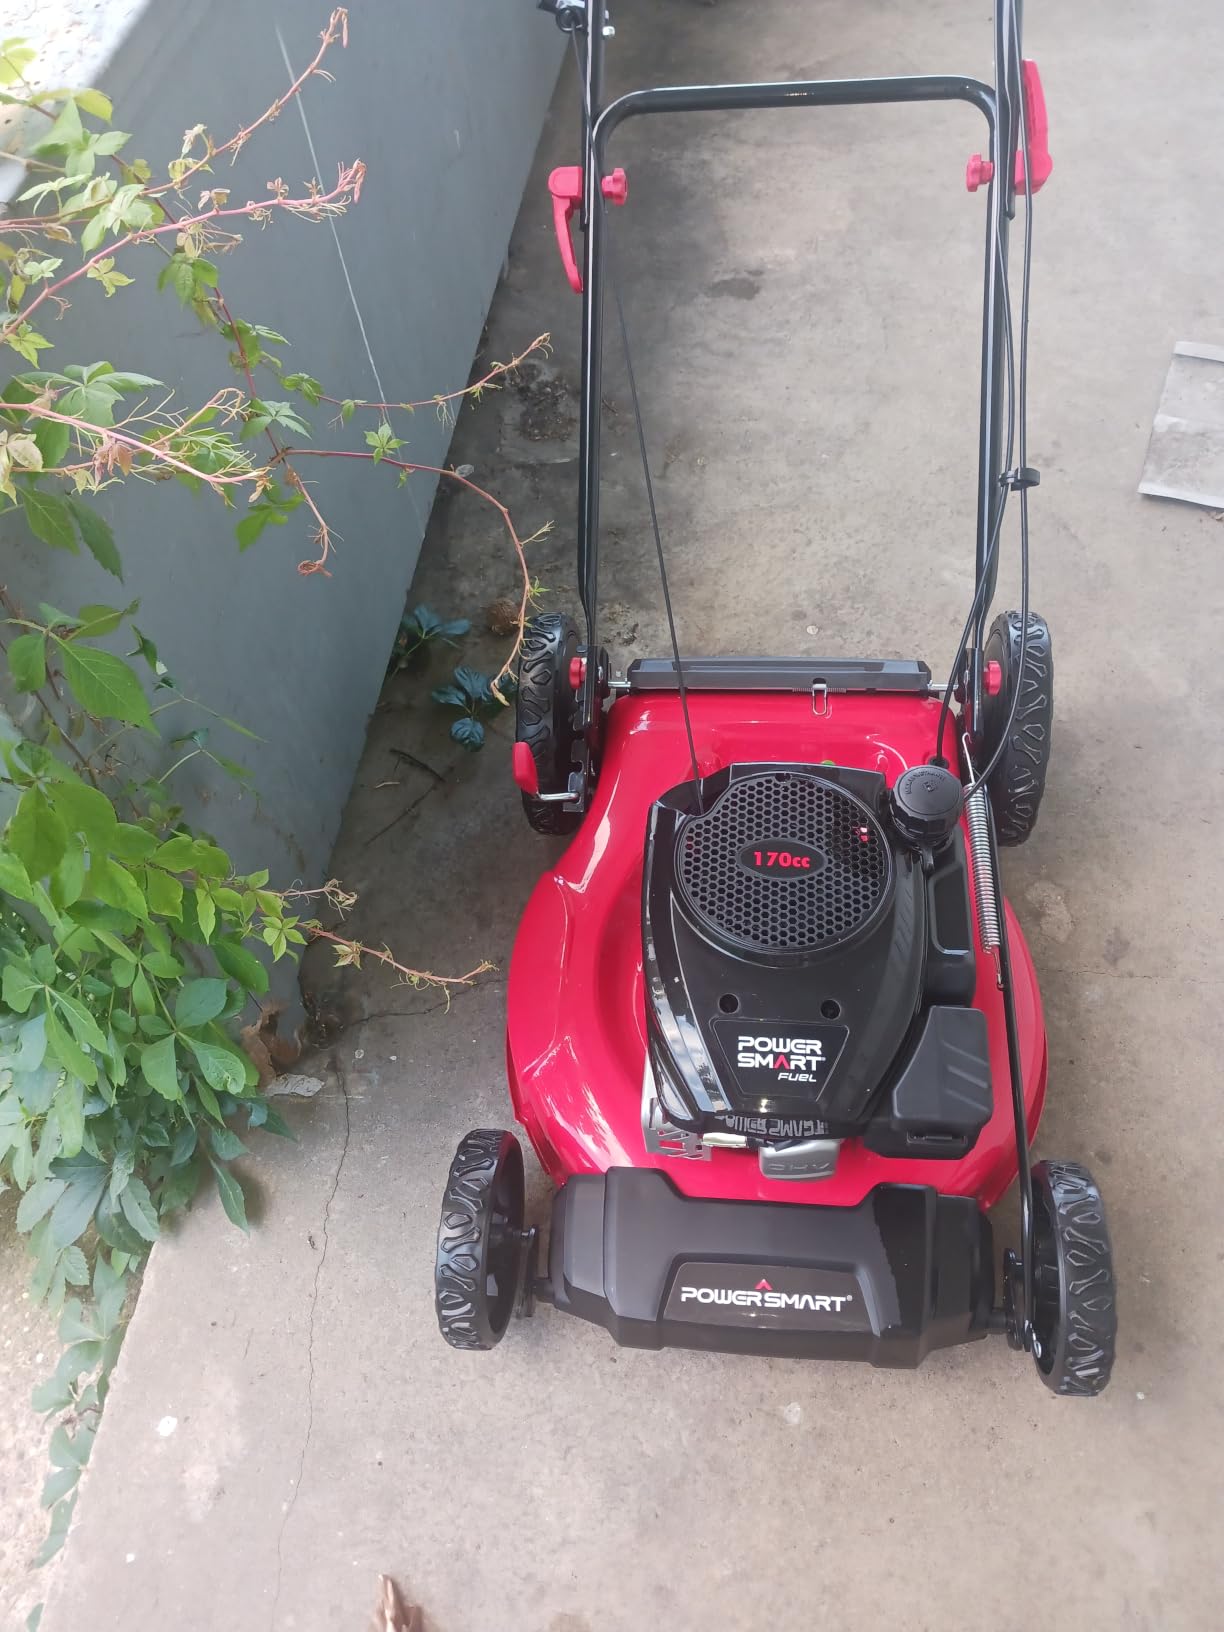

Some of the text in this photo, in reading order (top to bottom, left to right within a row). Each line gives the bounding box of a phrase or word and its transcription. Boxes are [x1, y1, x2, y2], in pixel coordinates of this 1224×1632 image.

[753, 850, 811, 868] 170cc
[737, 1035, 823, 1055] POWER
[737, 1052, 823, 1071] SMART
